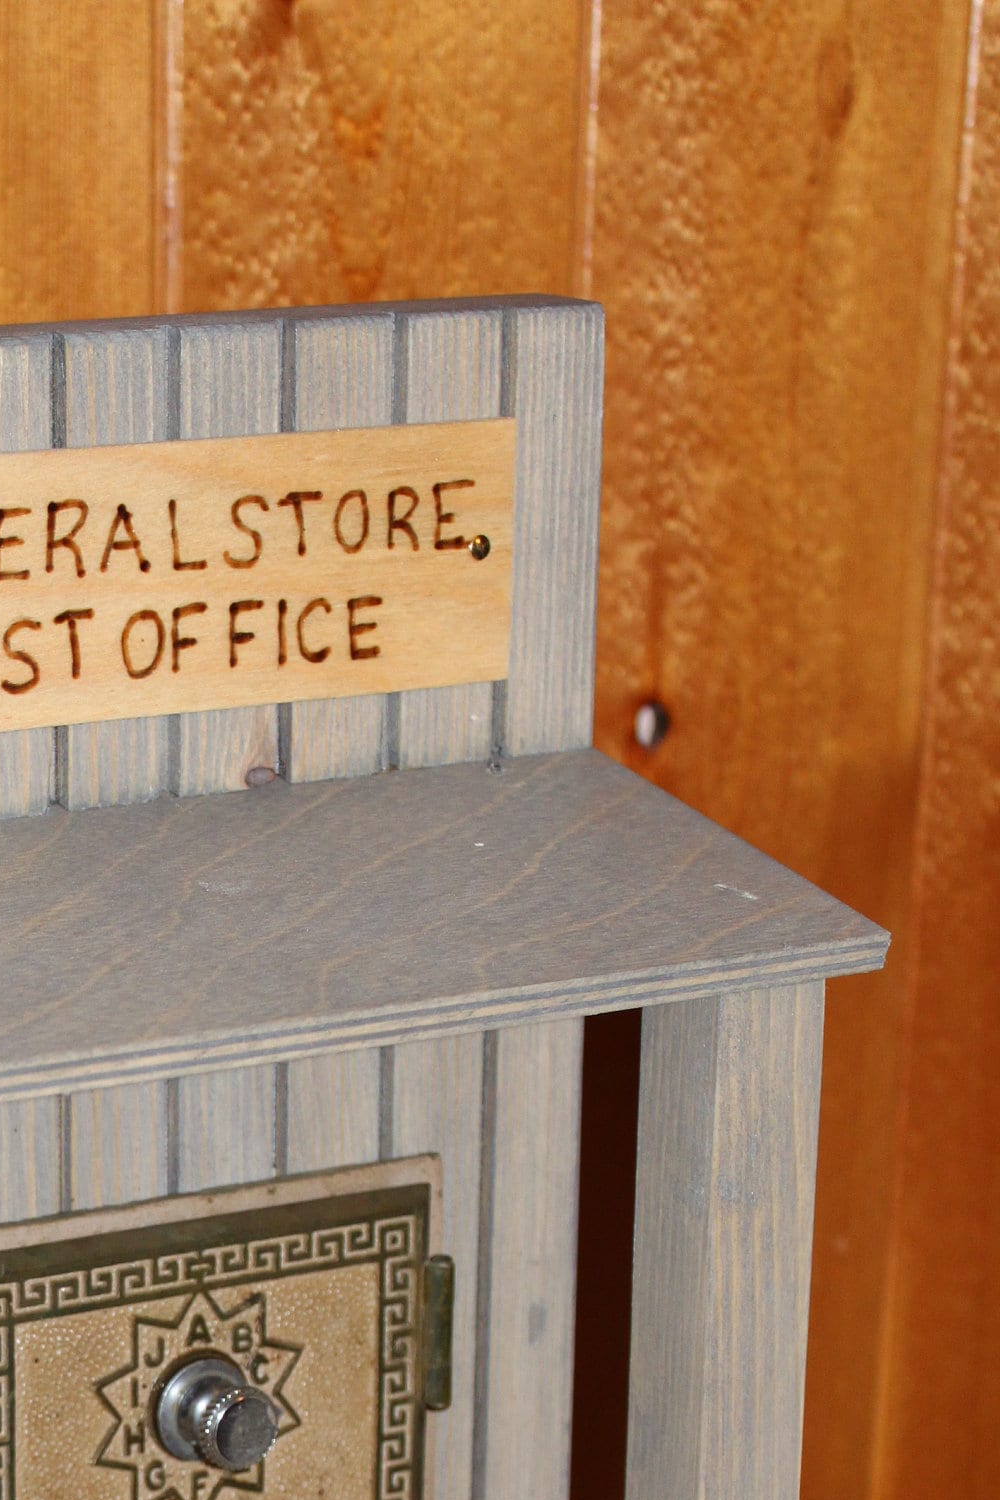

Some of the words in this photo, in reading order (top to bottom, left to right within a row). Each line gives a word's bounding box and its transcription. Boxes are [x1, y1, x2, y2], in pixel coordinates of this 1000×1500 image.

[223, 479, 474, 570] STORE
[121, 595, 383, 679] OFFICE
[187, 1315, 212, 1346] A
[232, 1322, 253, 1353] B
[143, 1338, 165, 1368] J
[251, 1354, 269, 1384] C
[124, 1422, 146, 1456] H
[145, 1461, 165, 1490] G
[191, 1471, 208, 1500] F
